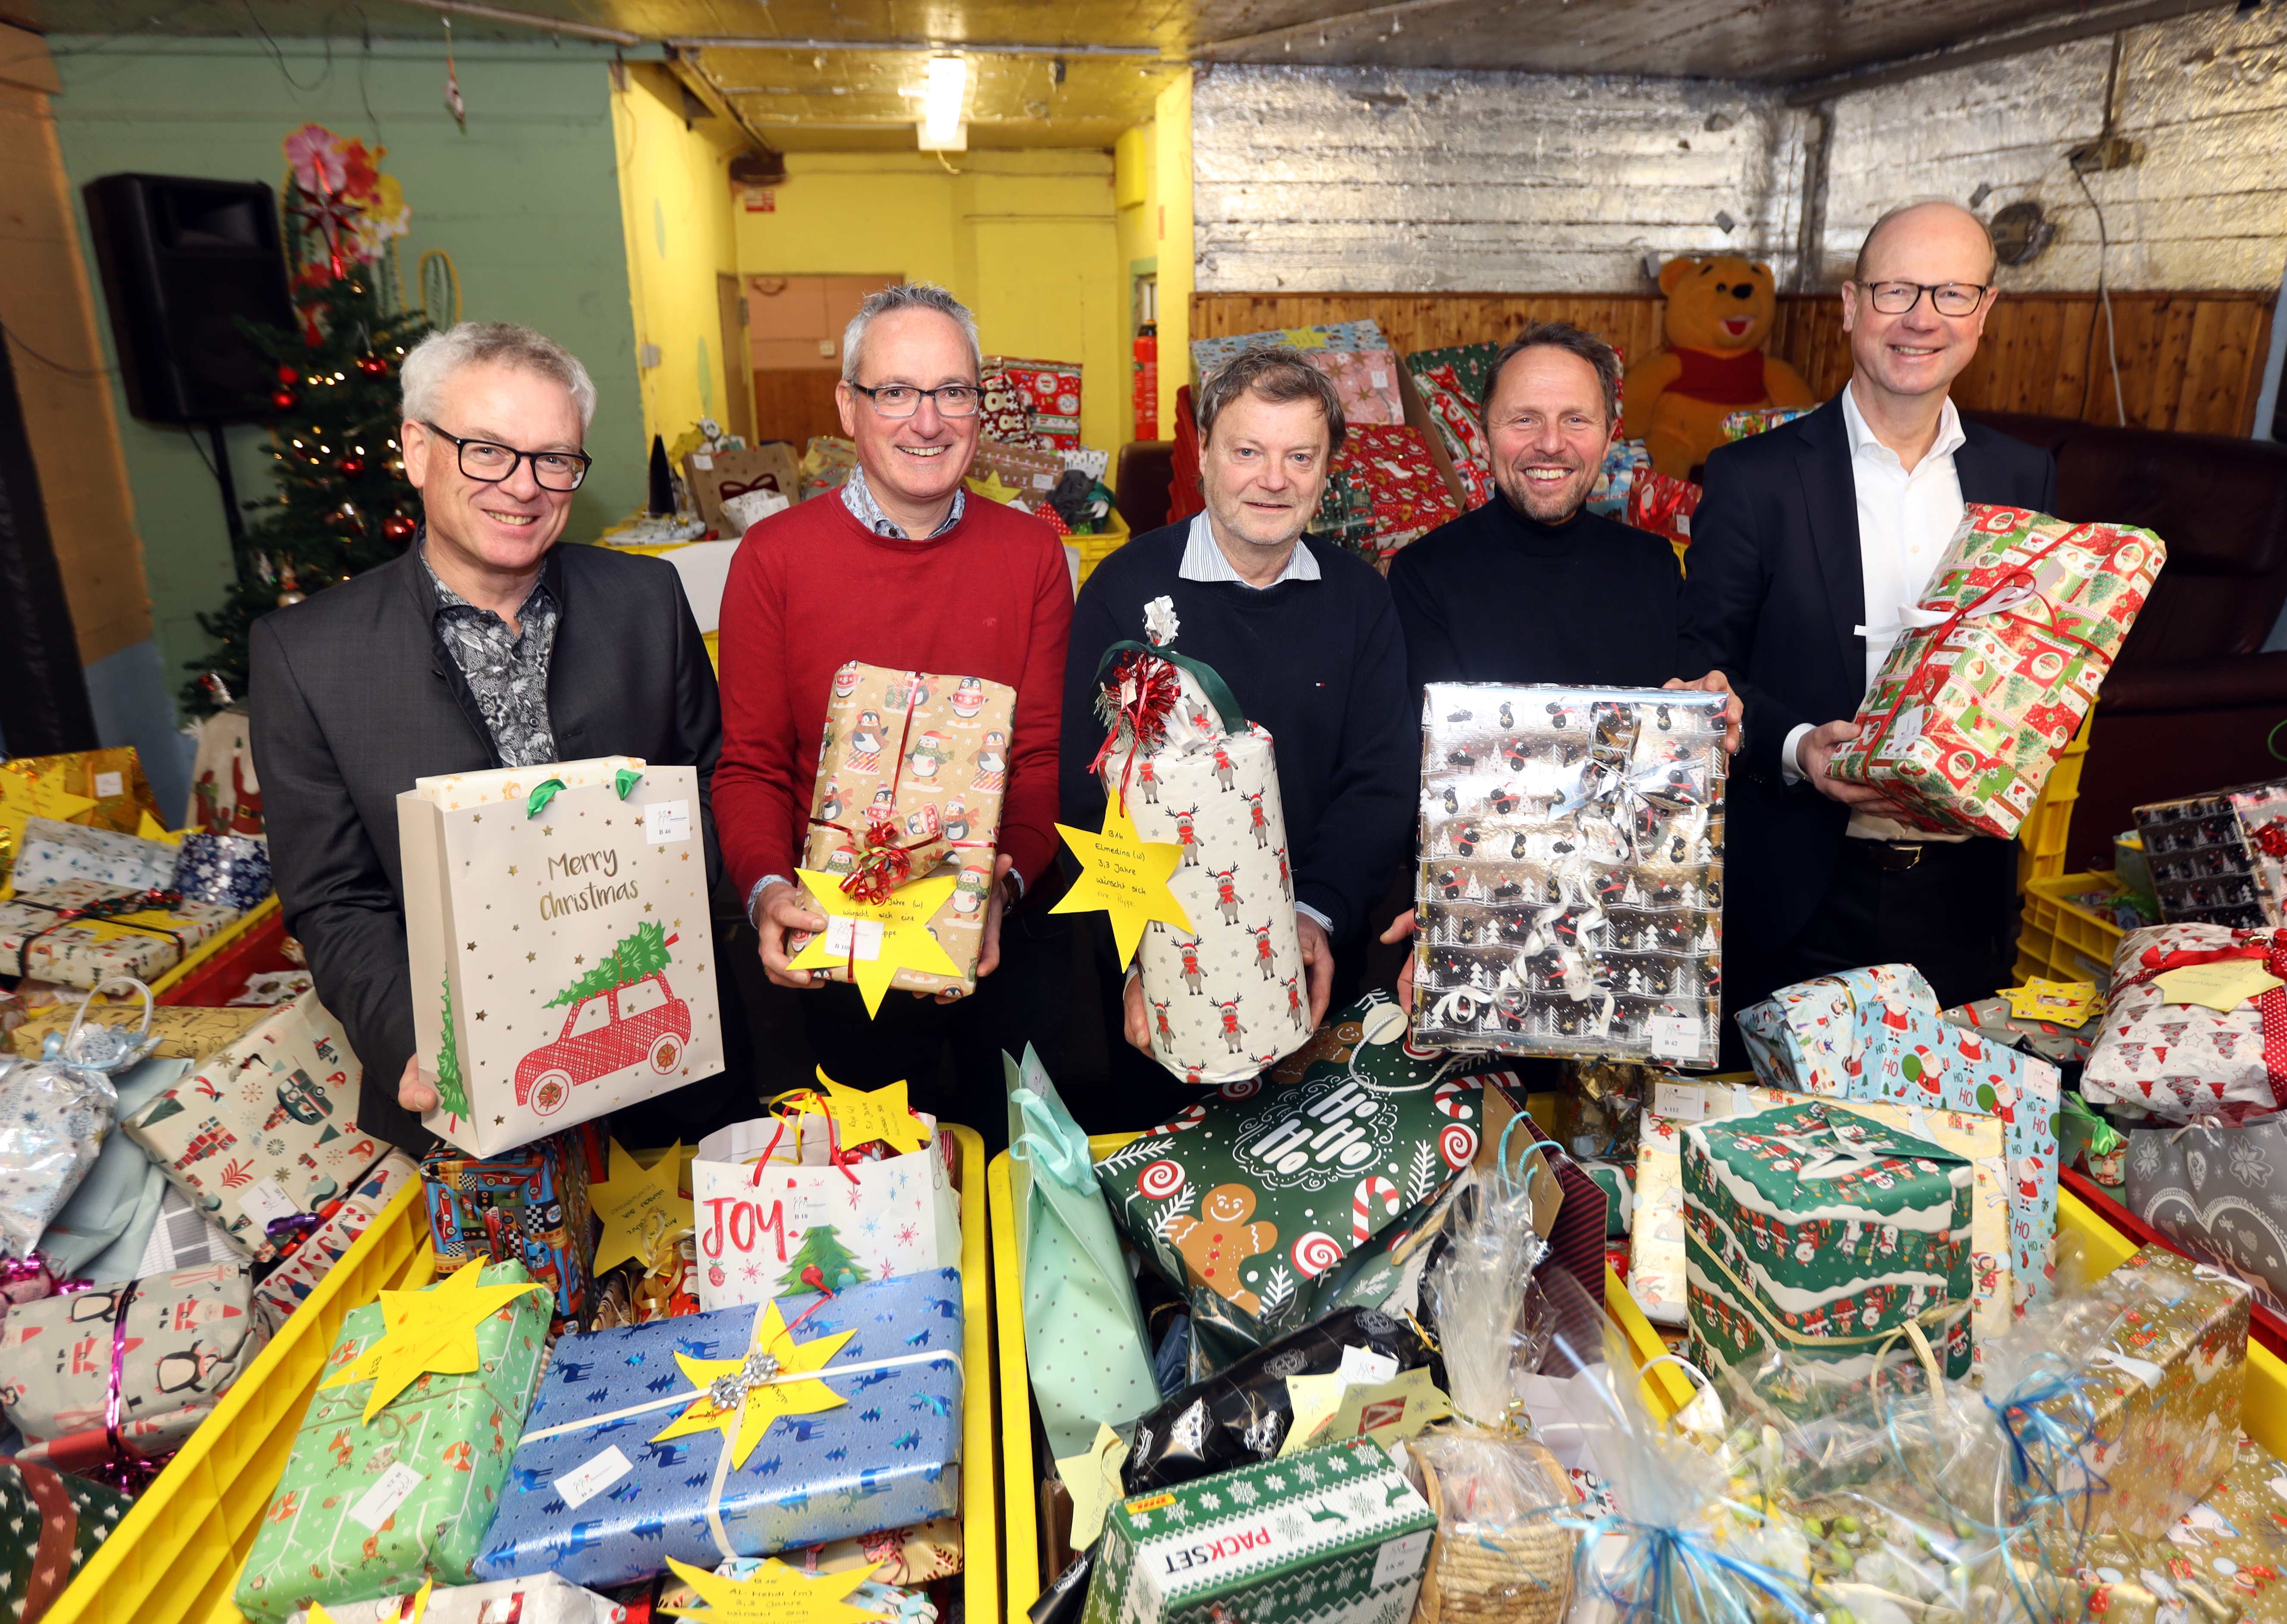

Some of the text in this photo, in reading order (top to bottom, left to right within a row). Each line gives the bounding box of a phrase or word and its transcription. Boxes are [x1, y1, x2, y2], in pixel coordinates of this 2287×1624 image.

[1108, 830, 1123, 839] B16
[1095, 843, 1145, 862] Elmedina (w)
[548, 849, 618, 881] Merry
[1114, 863, 1136, 875] Jahre
[1096, 876, 1146, 895] wünscht sich
[541, 880, 638, 921] Christmas
[888, 898, 905, 906] Jahre
[1097, 890, 1136, 909] eine Puppe
[883, 930, 897, 938] ppe
[1875, 1043, 1887, 1055] HO
[1882, 1057, 1899, 1077] HO
[1953, 1072, 1963, 1083] HO
[1307, 1082, 1379, 1124] Ho
[1959, 1087, 1973, 1107] HO
[2027, 1101, 2036, 1112] HO
[2032, 1116, 2046, 1135] HO
[1250, 1118, 1309, 1174] Ho
[1309, 1118, 1372, 1166] Ho
[2012, 1144, 2021, 1155] HO
[2015, 1218, 2030, 1240] HO
[2028, 1240, 2038, 1251] HO
[1166, 1526, 1272, 1574] PACKSET
